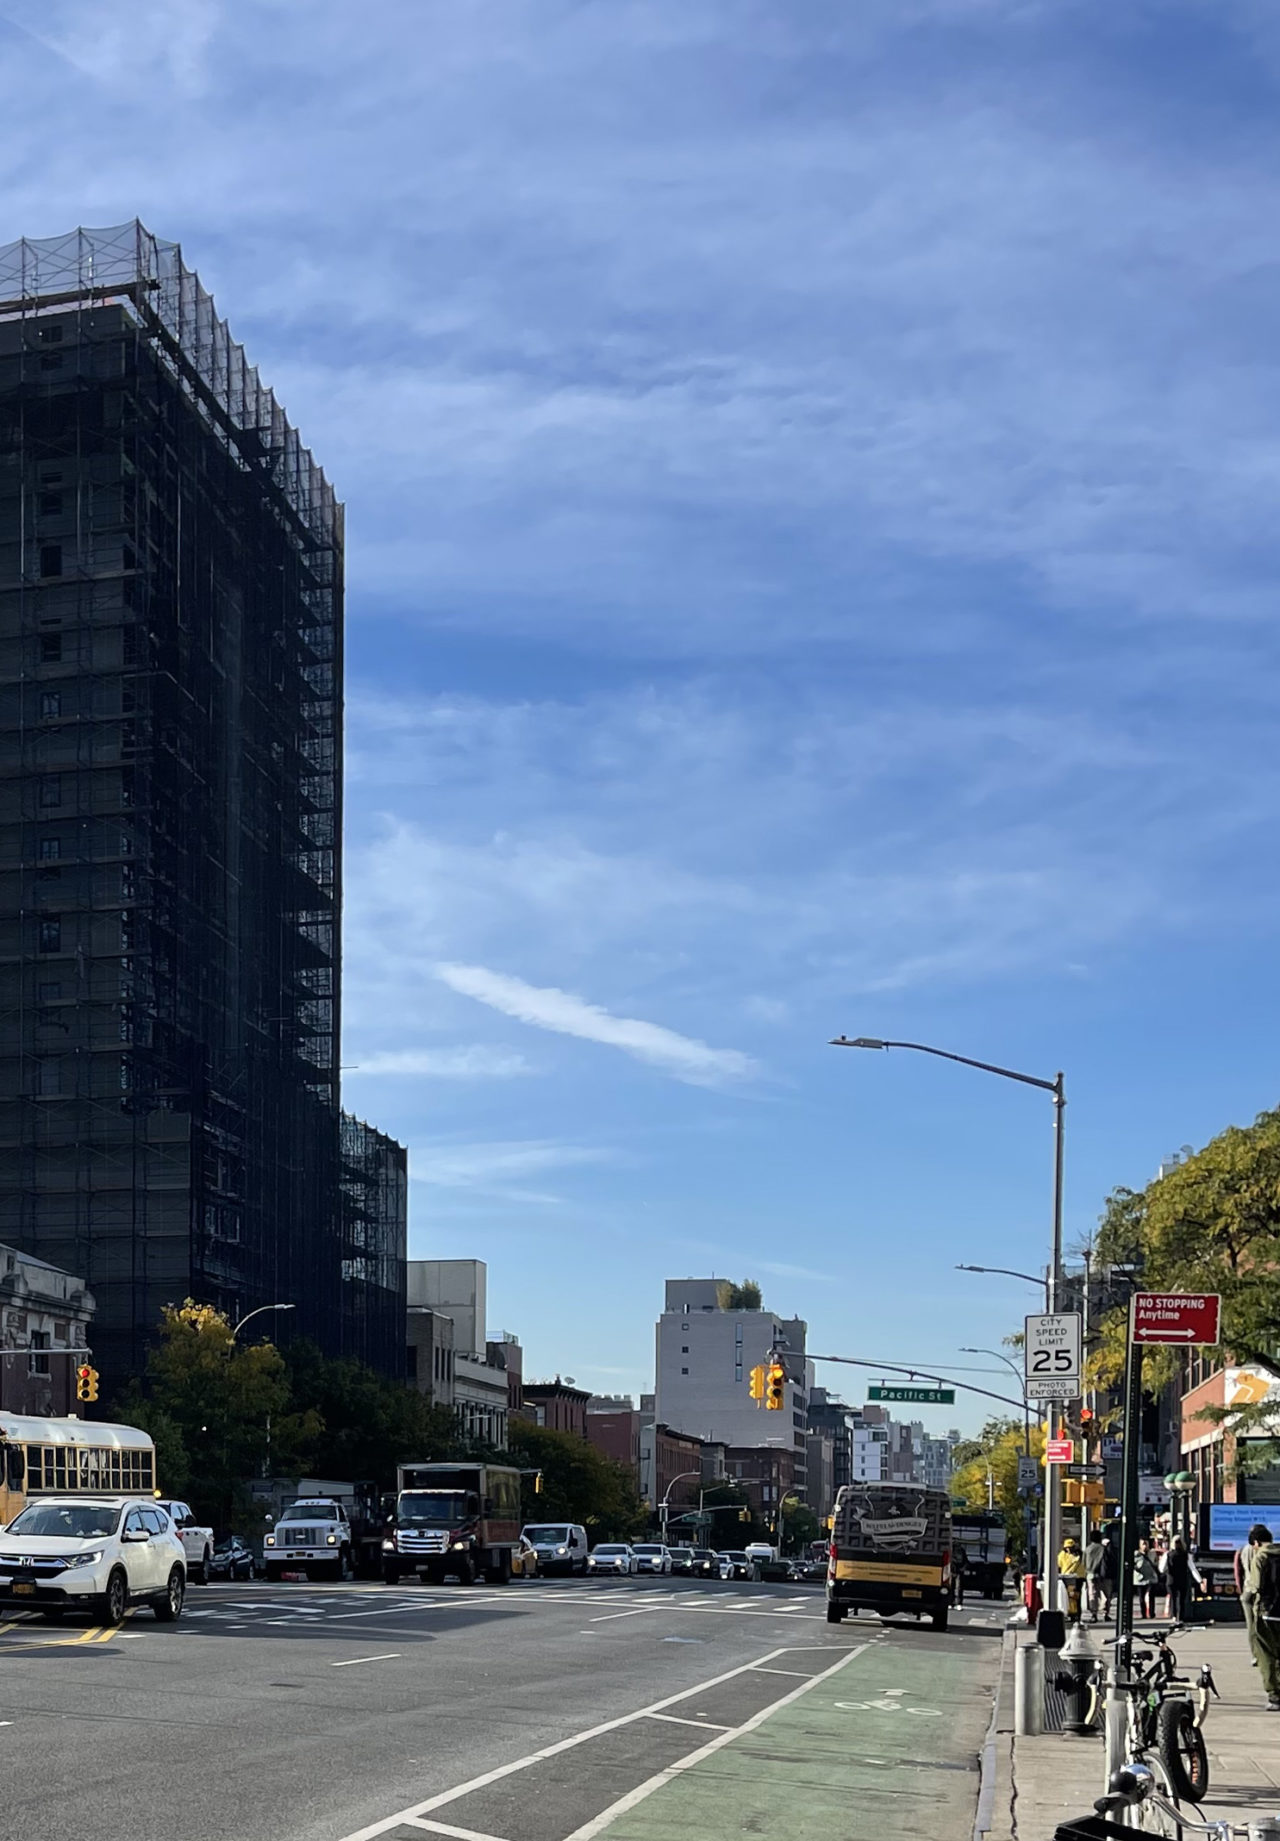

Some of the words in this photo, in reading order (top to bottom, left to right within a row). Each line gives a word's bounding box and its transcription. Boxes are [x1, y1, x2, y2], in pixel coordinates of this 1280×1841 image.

[1139, 1298, 1153, 1308] NO
[1155, 1298, 1205, 1309] STOPPING
[1139, 1309, 1180, 1321] Anytime
[1040, 1318, 1063, 1326] CITY
[1035, 1328, 1068, 1336] SPEED
[1038, 1338, 1064, 1346] LIMIT
[1032, 1349, 1073, 1372] 25
[1038, 1381, 1067, 1389] PHOTO
[880, 1389, 925, 1400] Pacific
[928, 1391, 942, 1401] St
[1030, 1388, 1075, 1396] ENFORCED
[1021, 1469, 1036, 1479] 25
